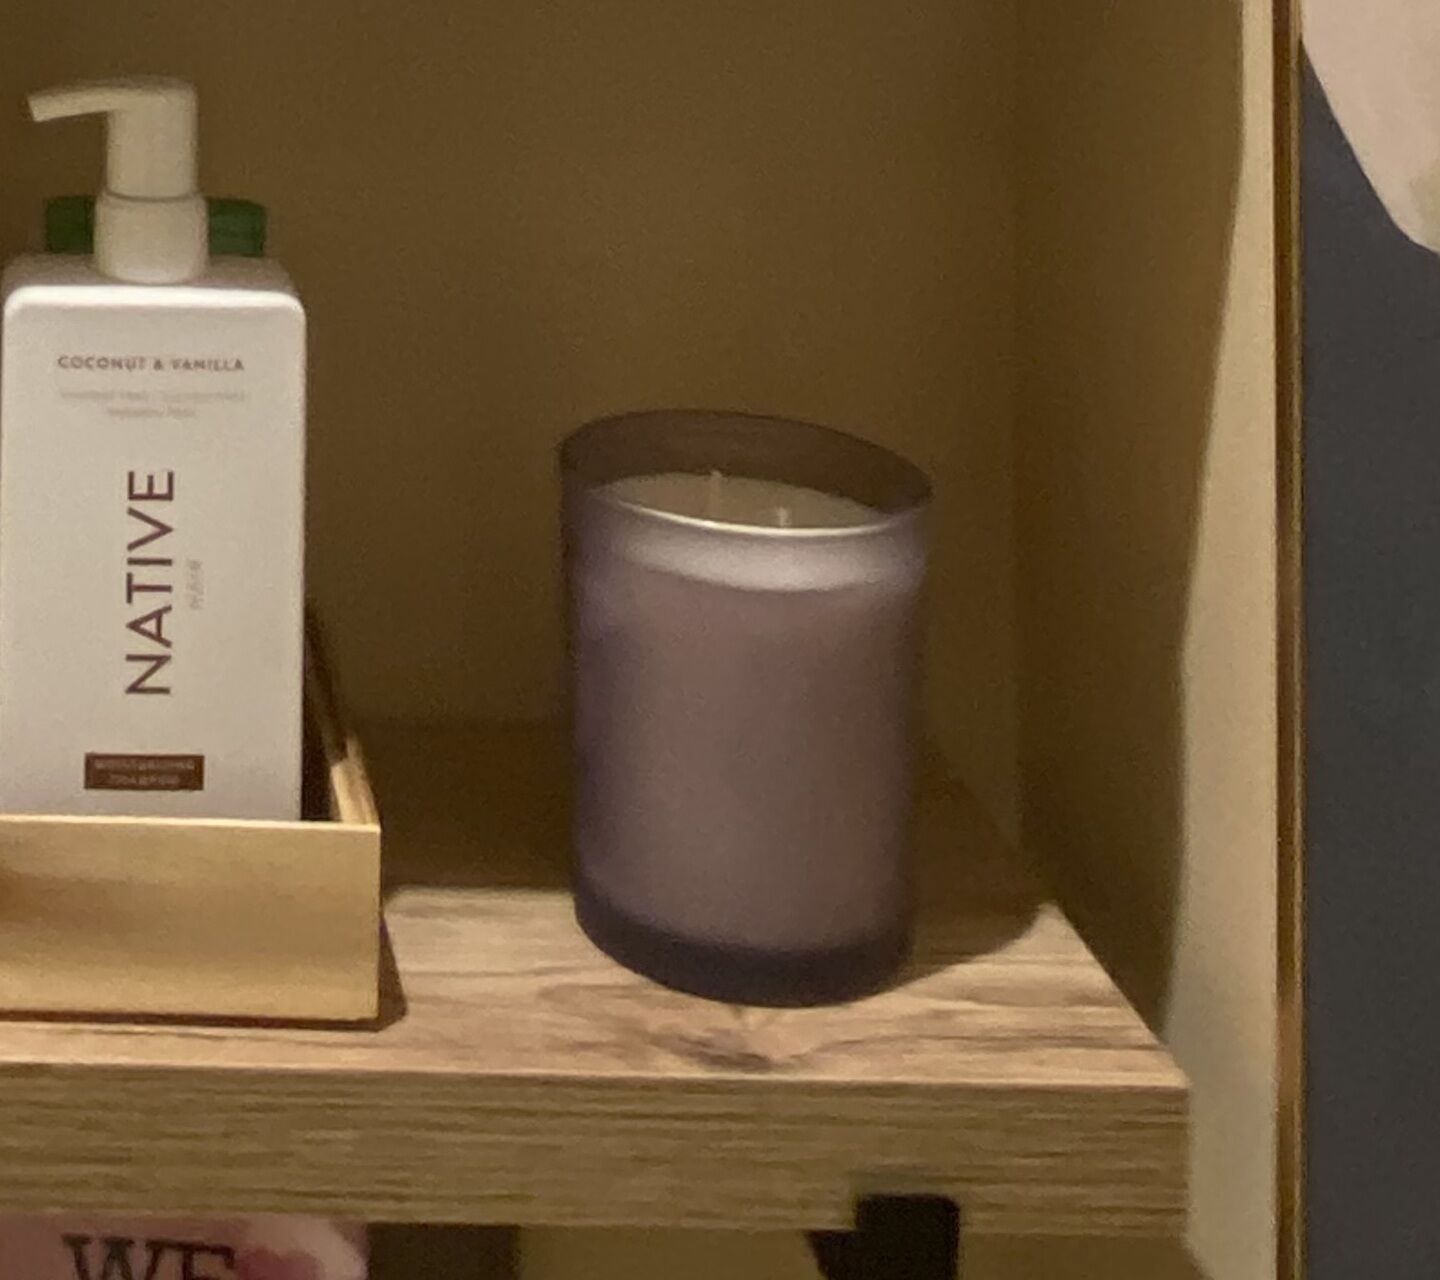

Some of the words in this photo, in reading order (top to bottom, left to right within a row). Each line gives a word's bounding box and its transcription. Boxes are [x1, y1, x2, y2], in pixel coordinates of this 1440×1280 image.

[57, 355, 145, 371] COCONUT
[172, 359, 245, 372] VANILLA
[123, 470, 174, 695] NATIVE
